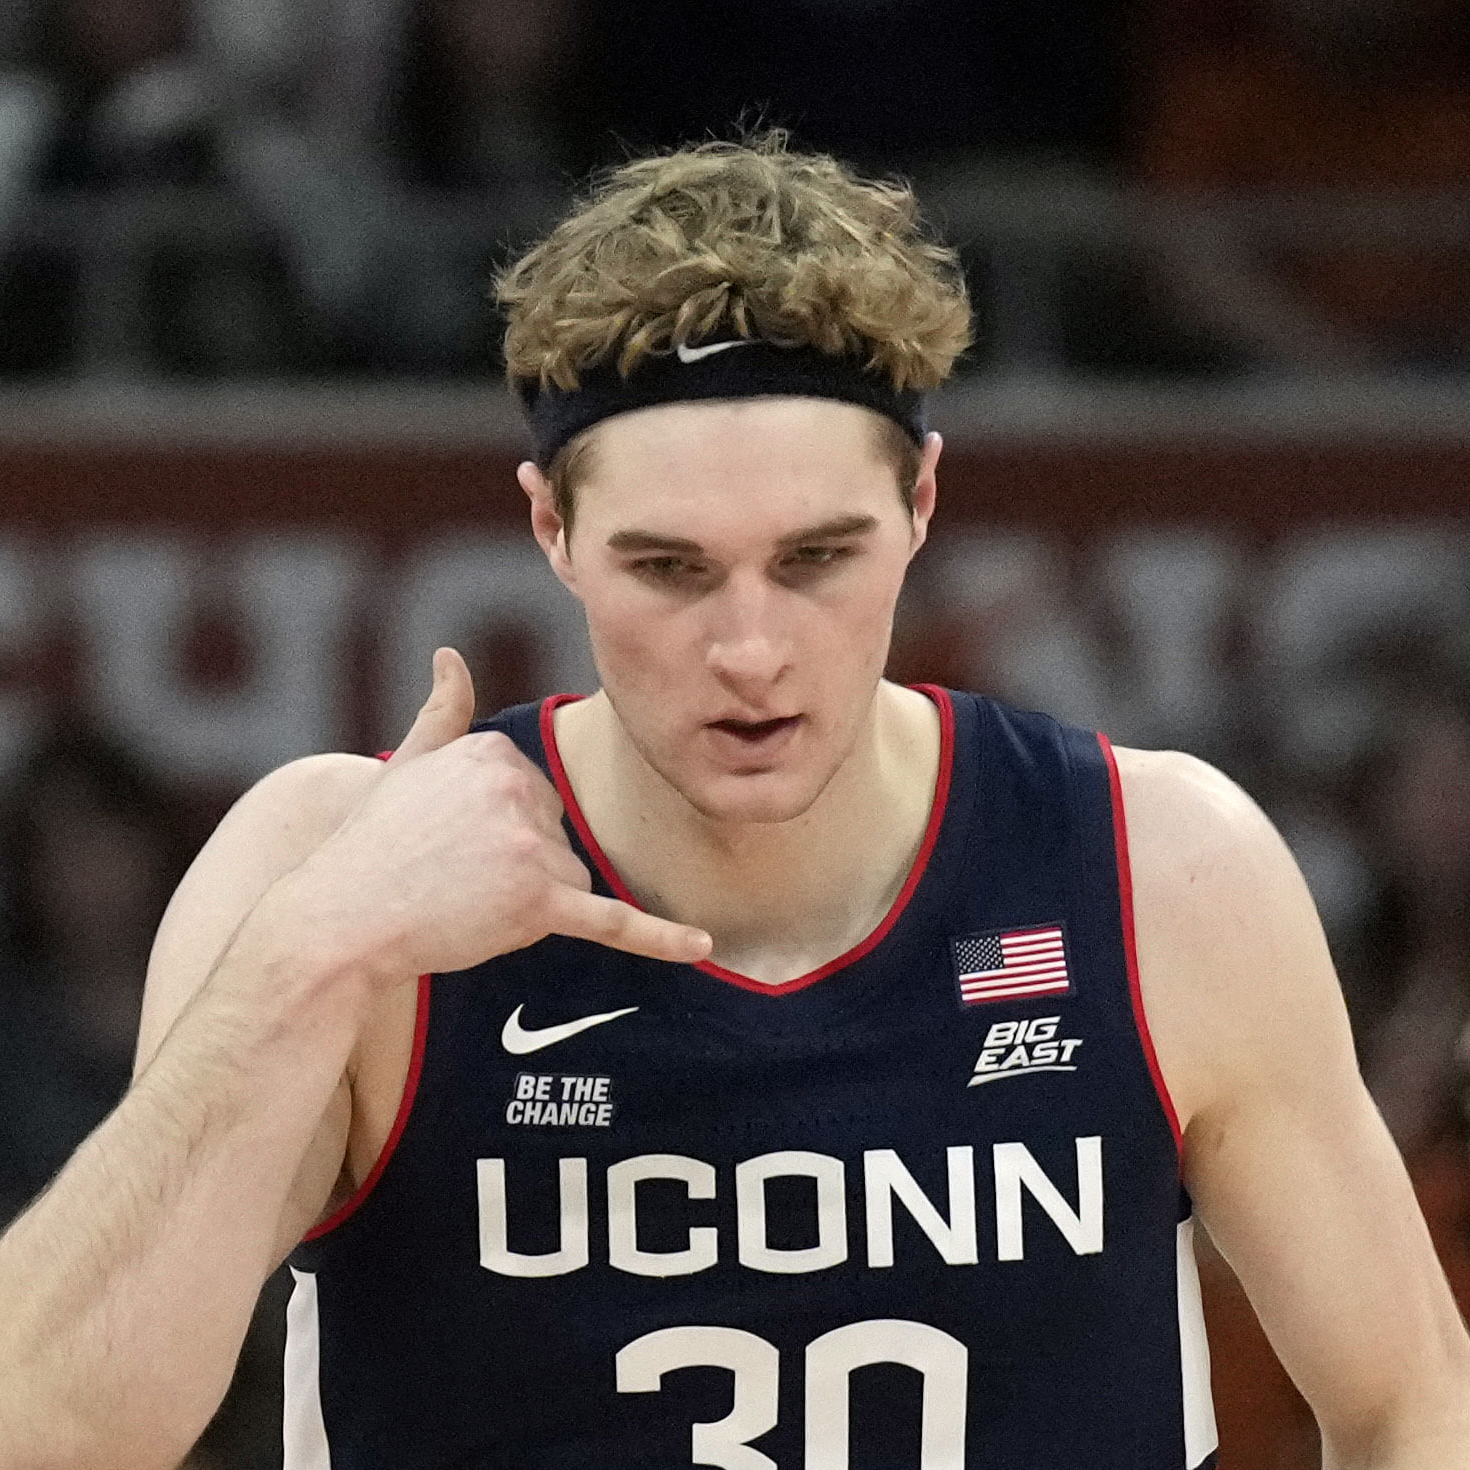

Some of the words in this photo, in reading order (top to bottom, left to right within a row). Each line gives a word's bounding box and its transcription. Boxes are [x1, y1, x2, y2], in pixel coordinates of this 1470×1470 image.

[984, 1016, 1061, 1048] BIG
[975, 1039, 1083, 1071] EAST
[516, 1074, 556, 1099] BE
[561, 1075, 610, 1102] THE
[506, 1101, 614, 1126] CHANGE
[477, 1136, 1104, 1278] UCONN
